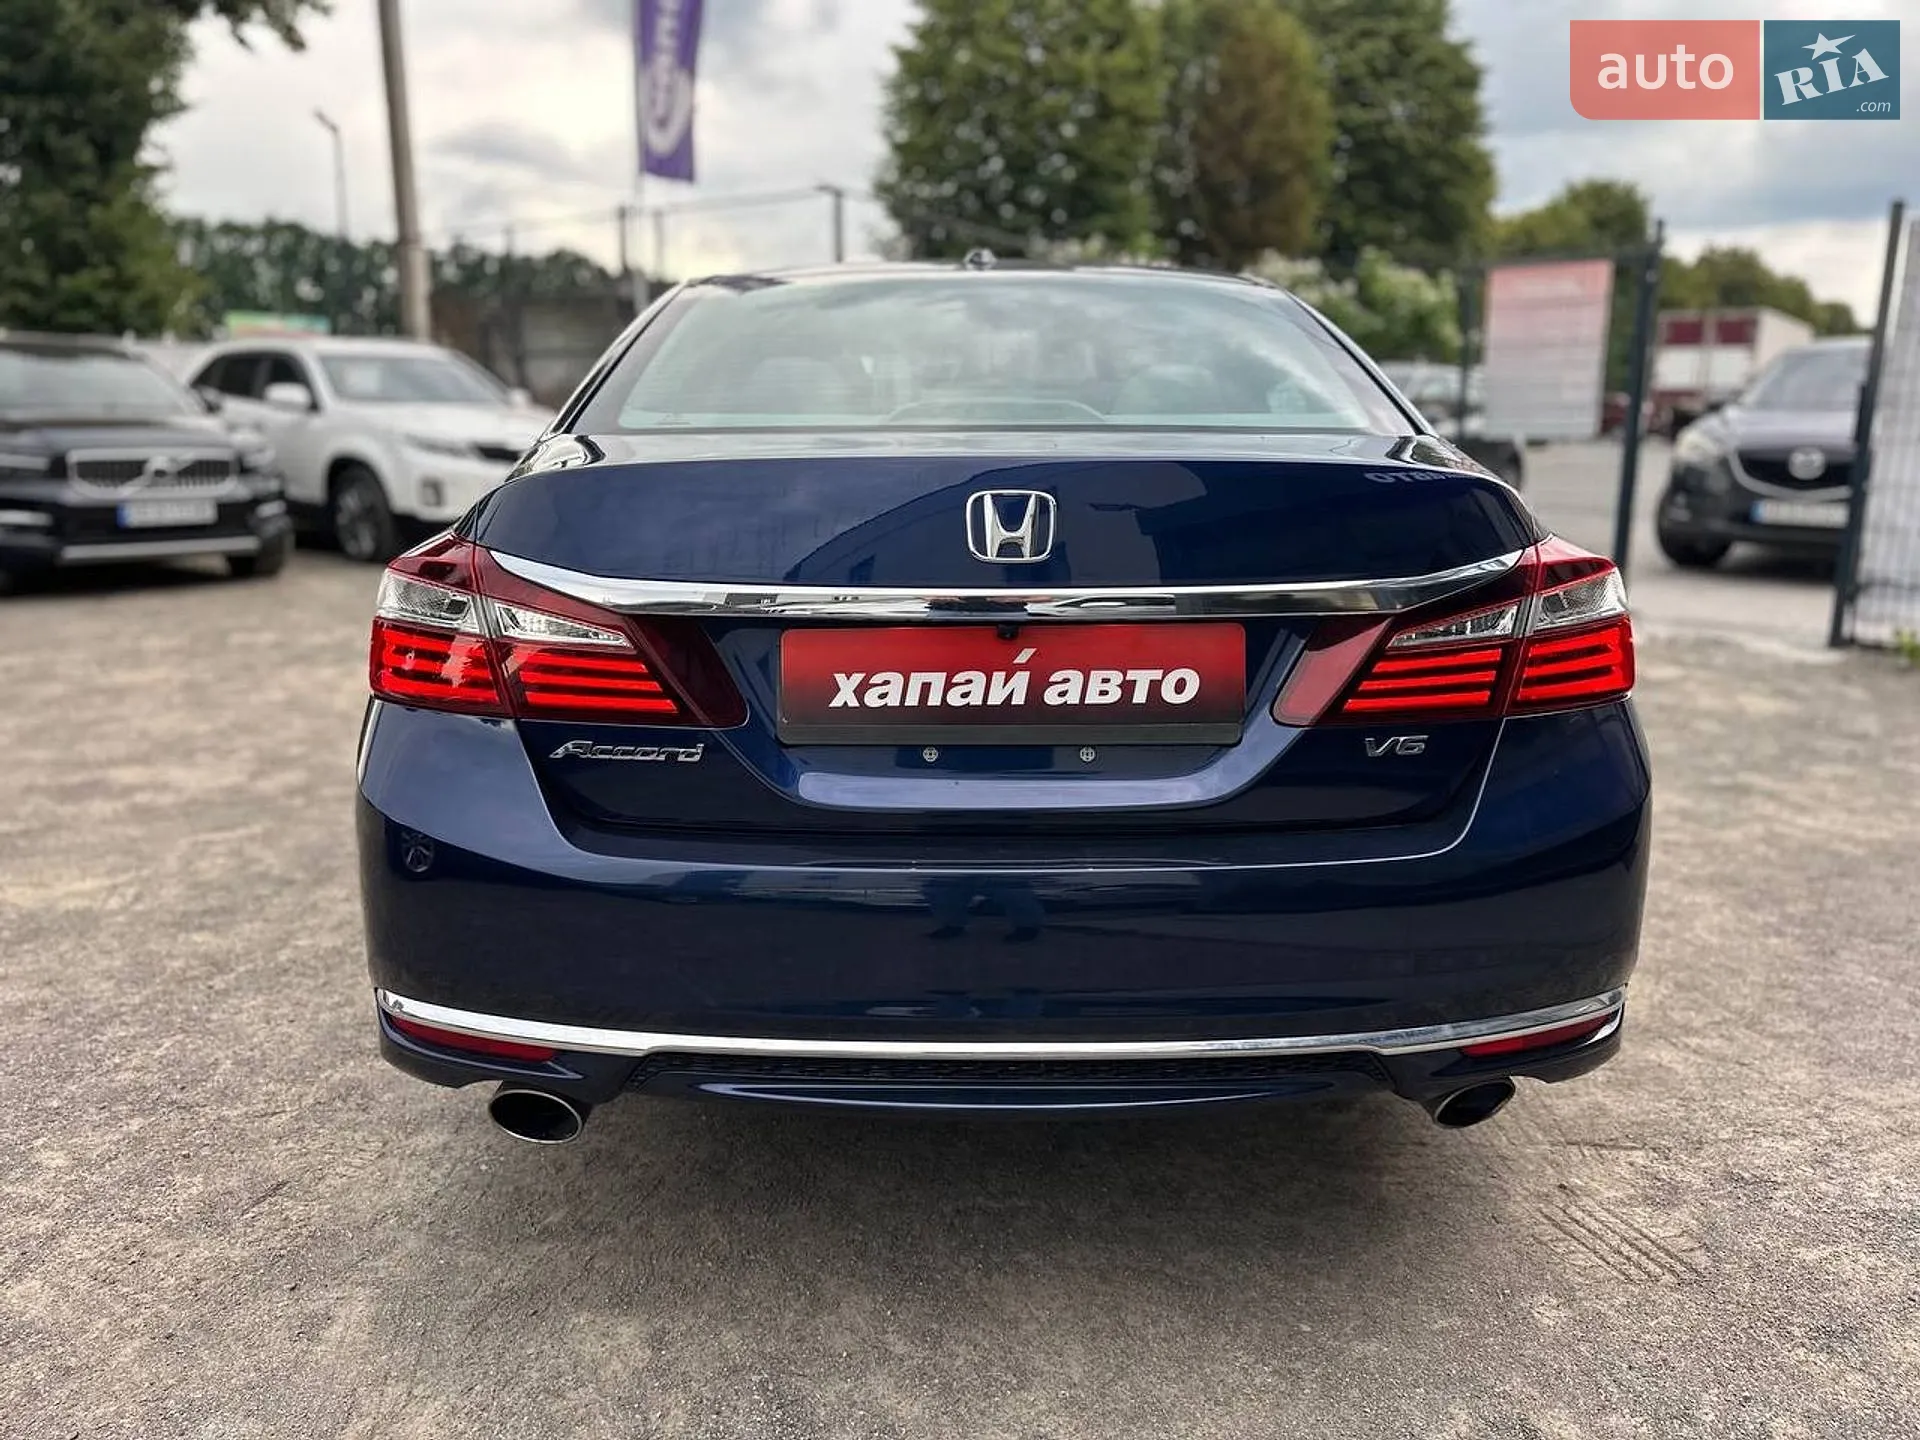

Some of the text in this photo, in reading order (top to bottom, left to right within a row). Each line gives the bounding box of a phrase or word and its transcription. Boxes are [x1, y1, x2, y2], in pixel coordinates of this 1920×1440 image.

[828, 648, 1200, 708] хапай авто
[549, 740, 705, 762] Accord
[1364, 735, 1429, 756] V6
